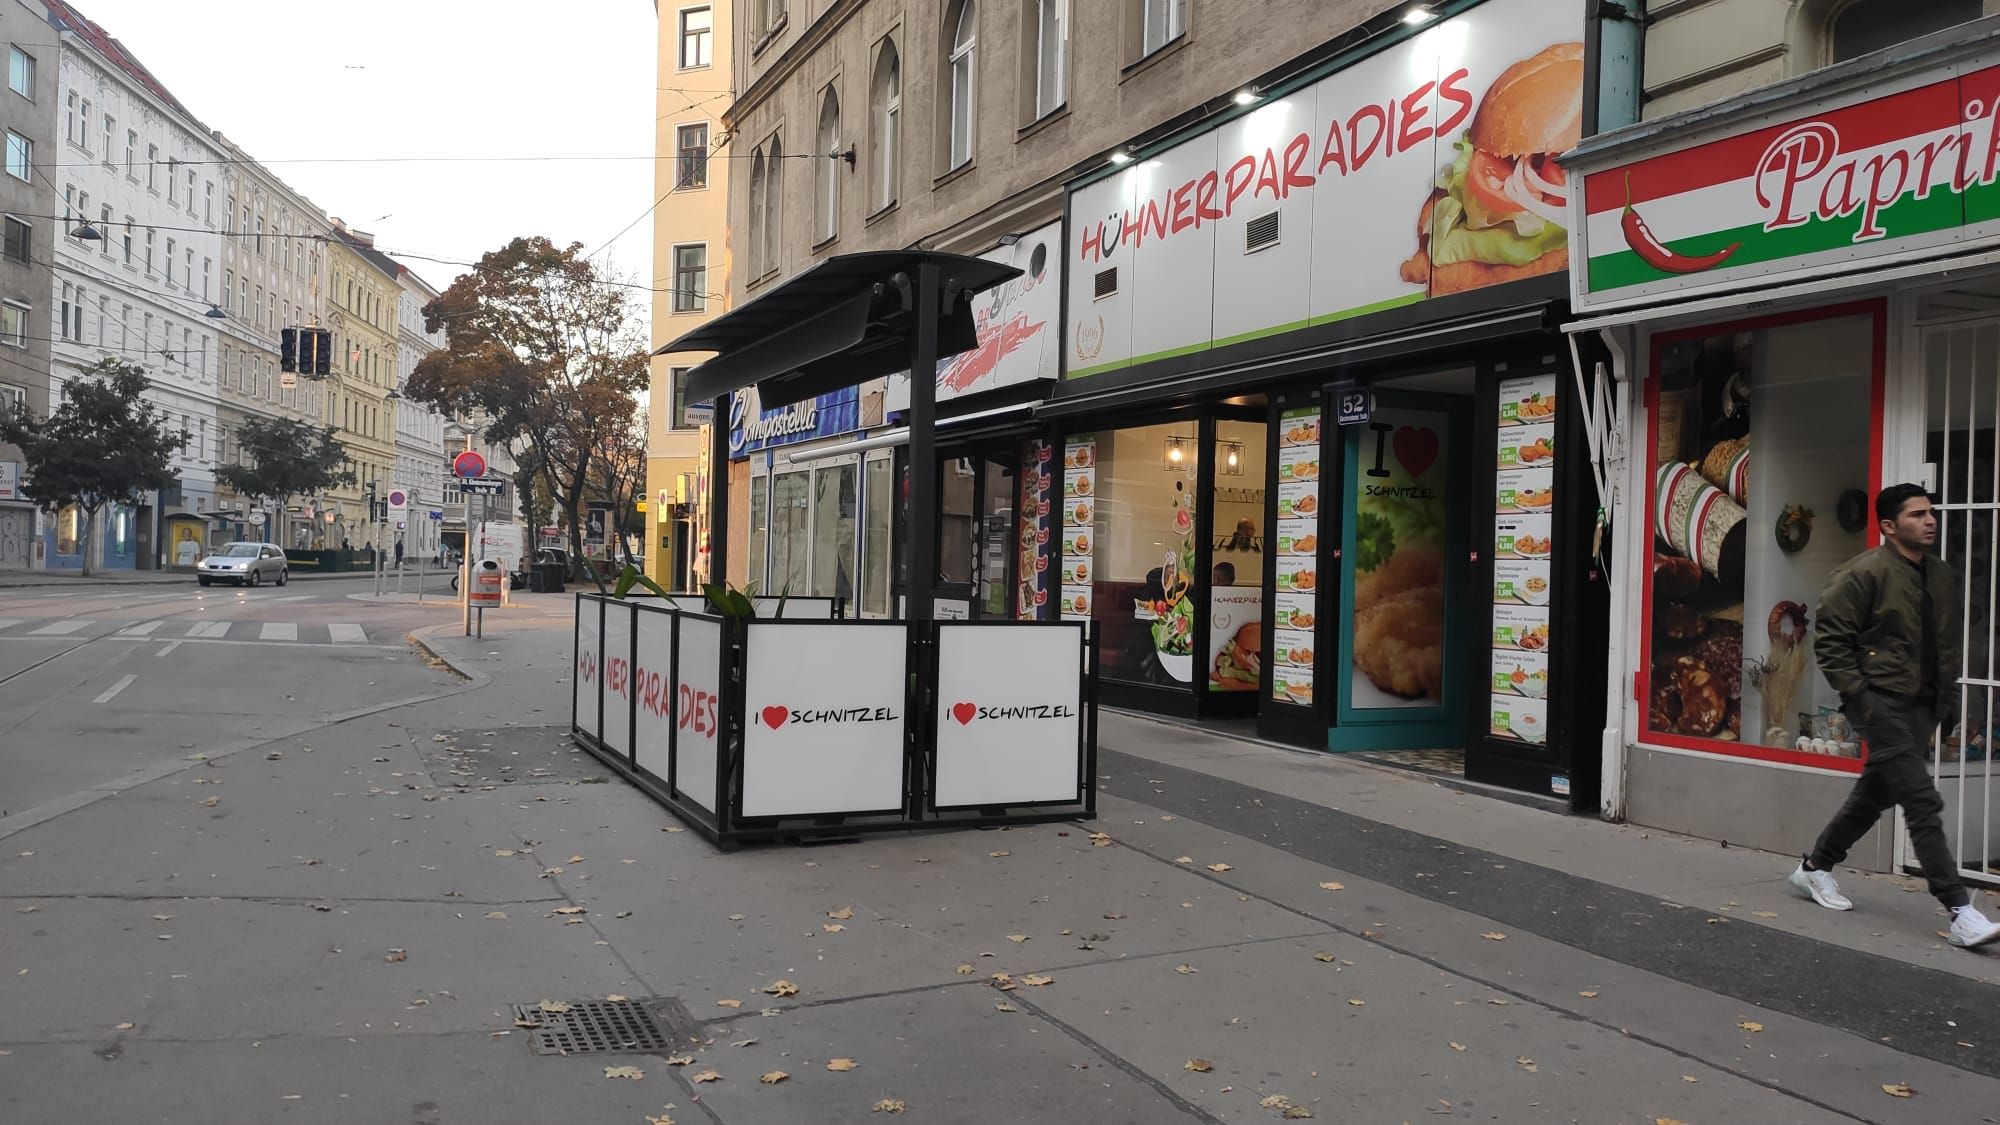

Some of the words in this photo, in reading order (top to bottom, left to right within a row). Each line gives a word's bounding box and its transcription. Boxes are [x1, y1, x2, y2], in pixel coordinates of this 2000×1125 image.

[1081, 67, 1474, 263] HÜHNERPARADIES
[1343, 393, 1364, 414] 52
[1366, 422, 1393, 478] I
[1365, 484, 1437, 499] SCHNITZEL
[606, 656, 627, 700] NER
[636, 667, 669, 719] PARA
[679, 683, 717, 738] DIES
[790, 707, 899, 724] SCHNITZEL
[978, 704, 1075, 720] SCHNITZEL
